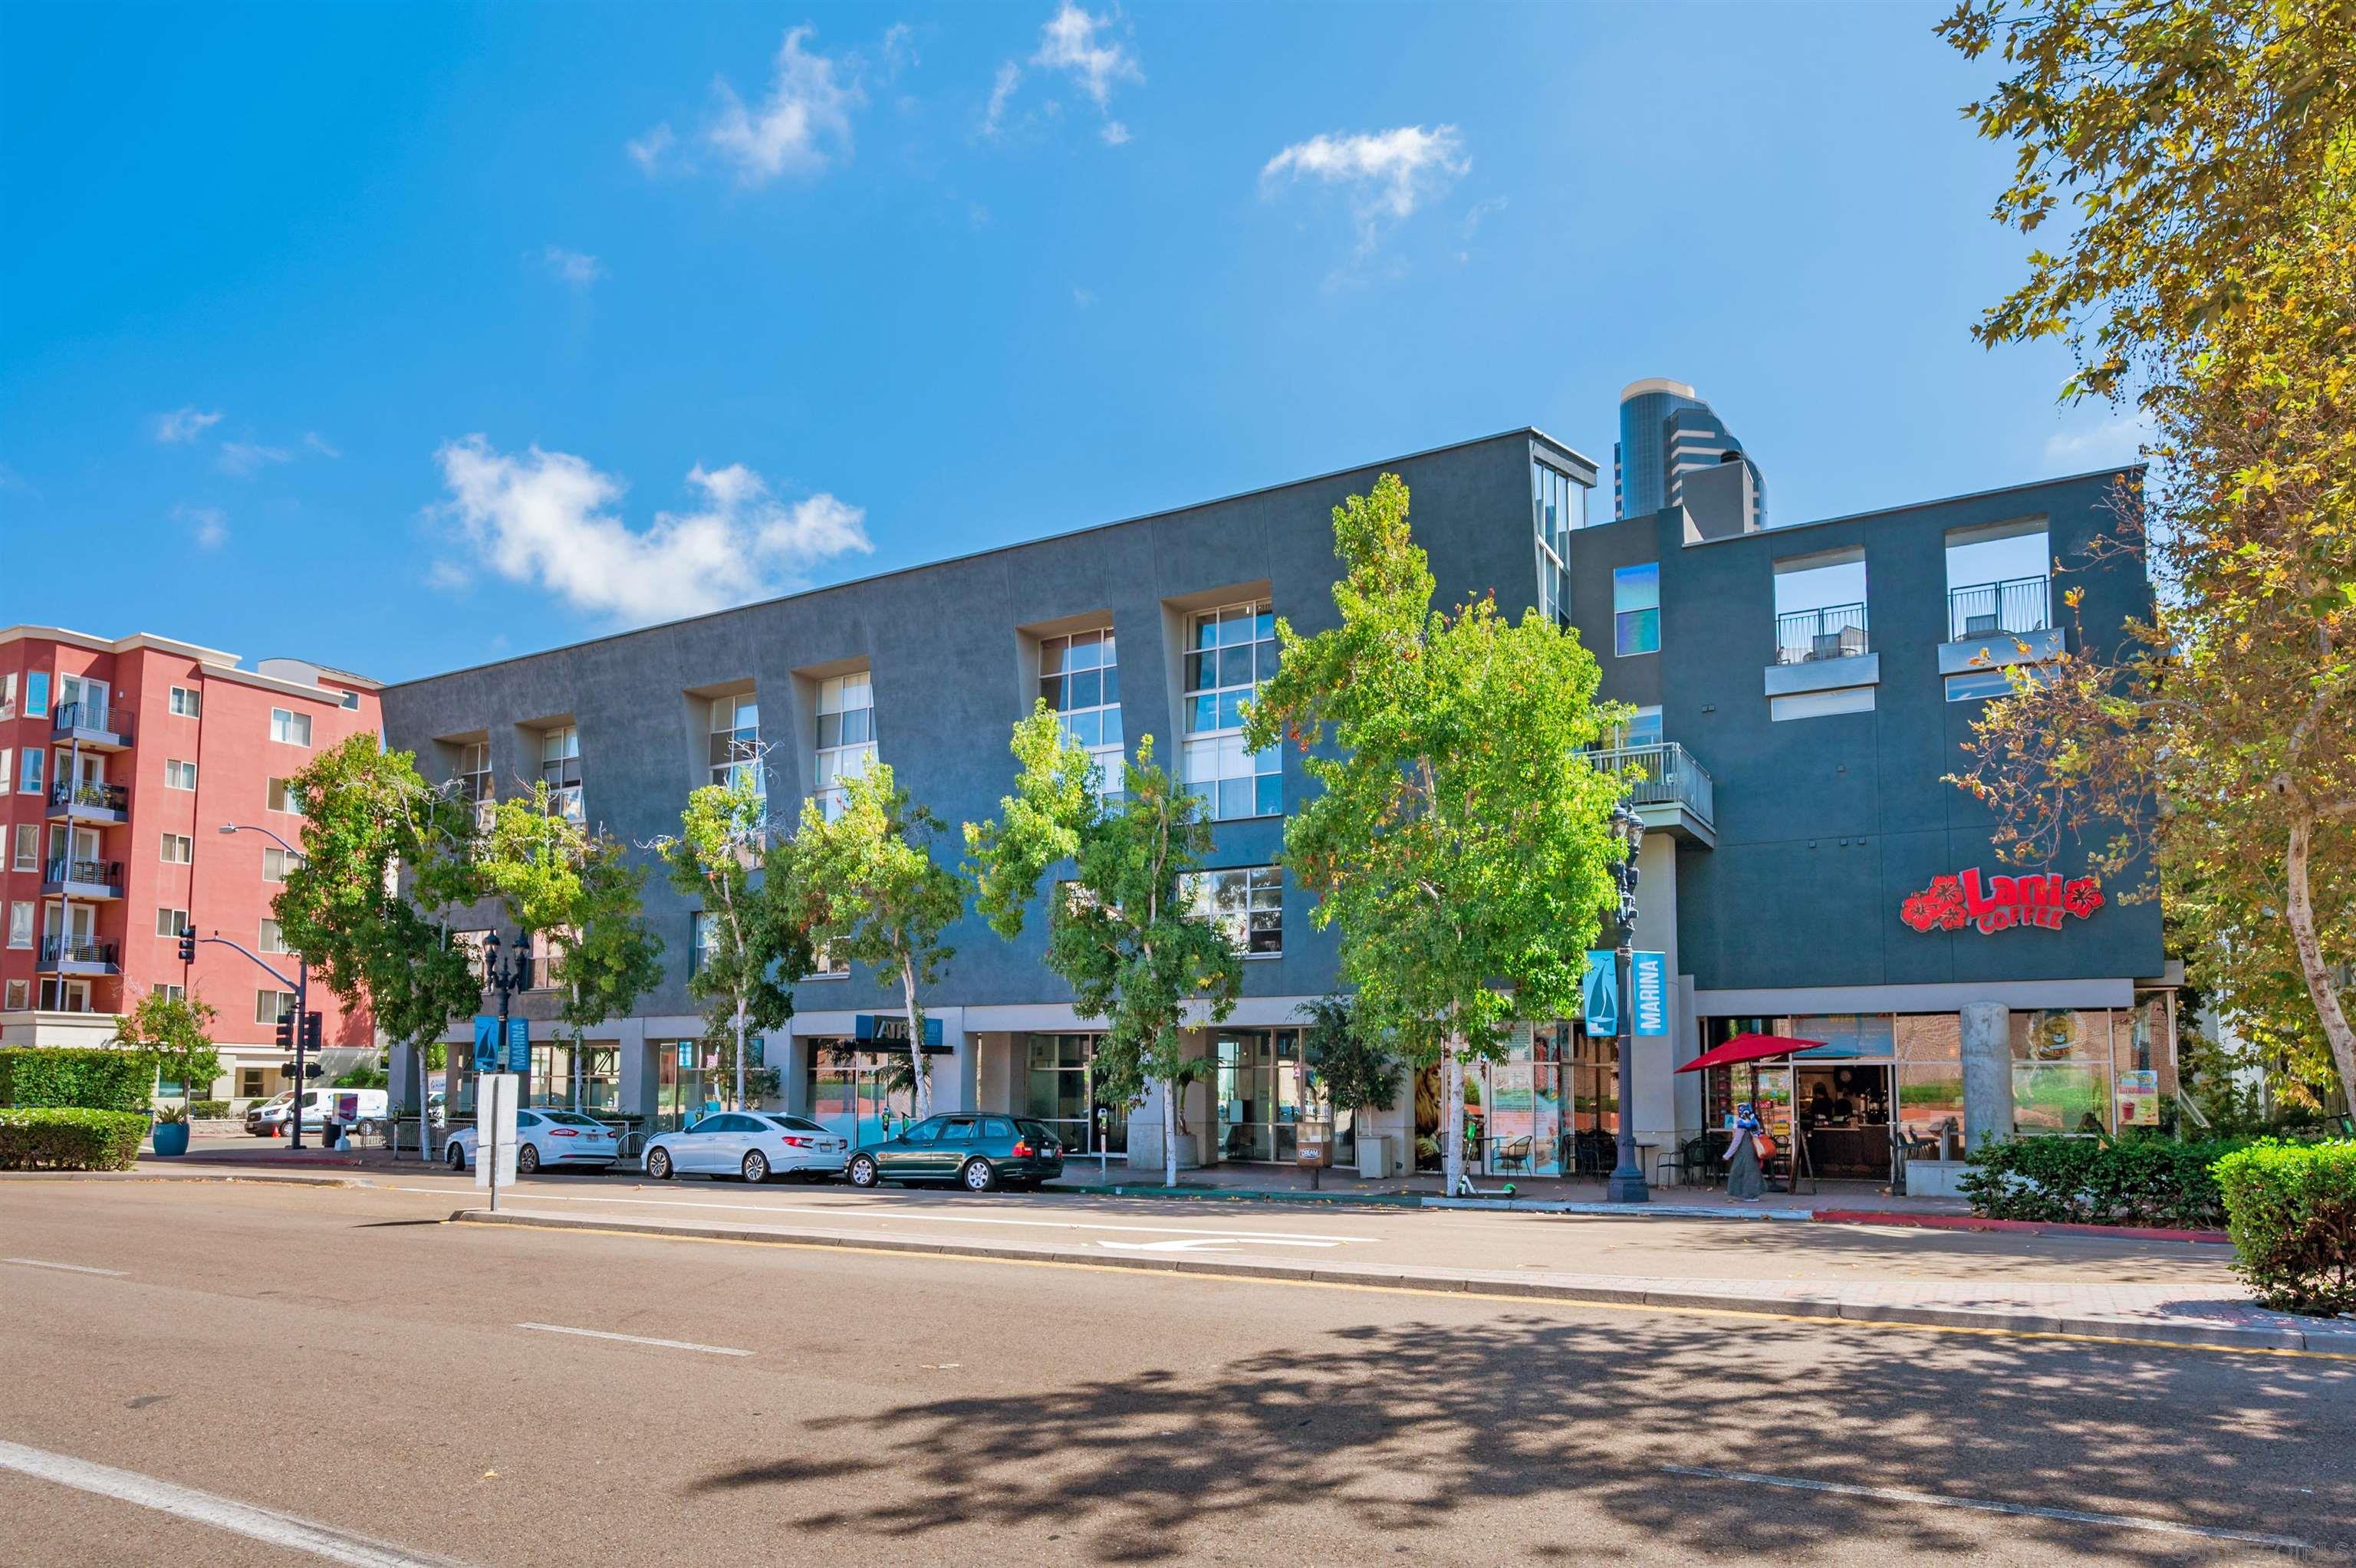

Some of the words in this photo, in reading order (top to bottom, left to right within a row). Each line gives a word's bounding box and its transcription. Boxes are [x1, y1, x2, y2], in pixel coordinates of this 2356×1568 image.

[1961, 868, 2062, 919] Lani
[1977, 908, 2064, 933] COFFEE
[1639, 960, 1661, 1029] MARINA
[512, 1023, 525, 1066] MARINA
